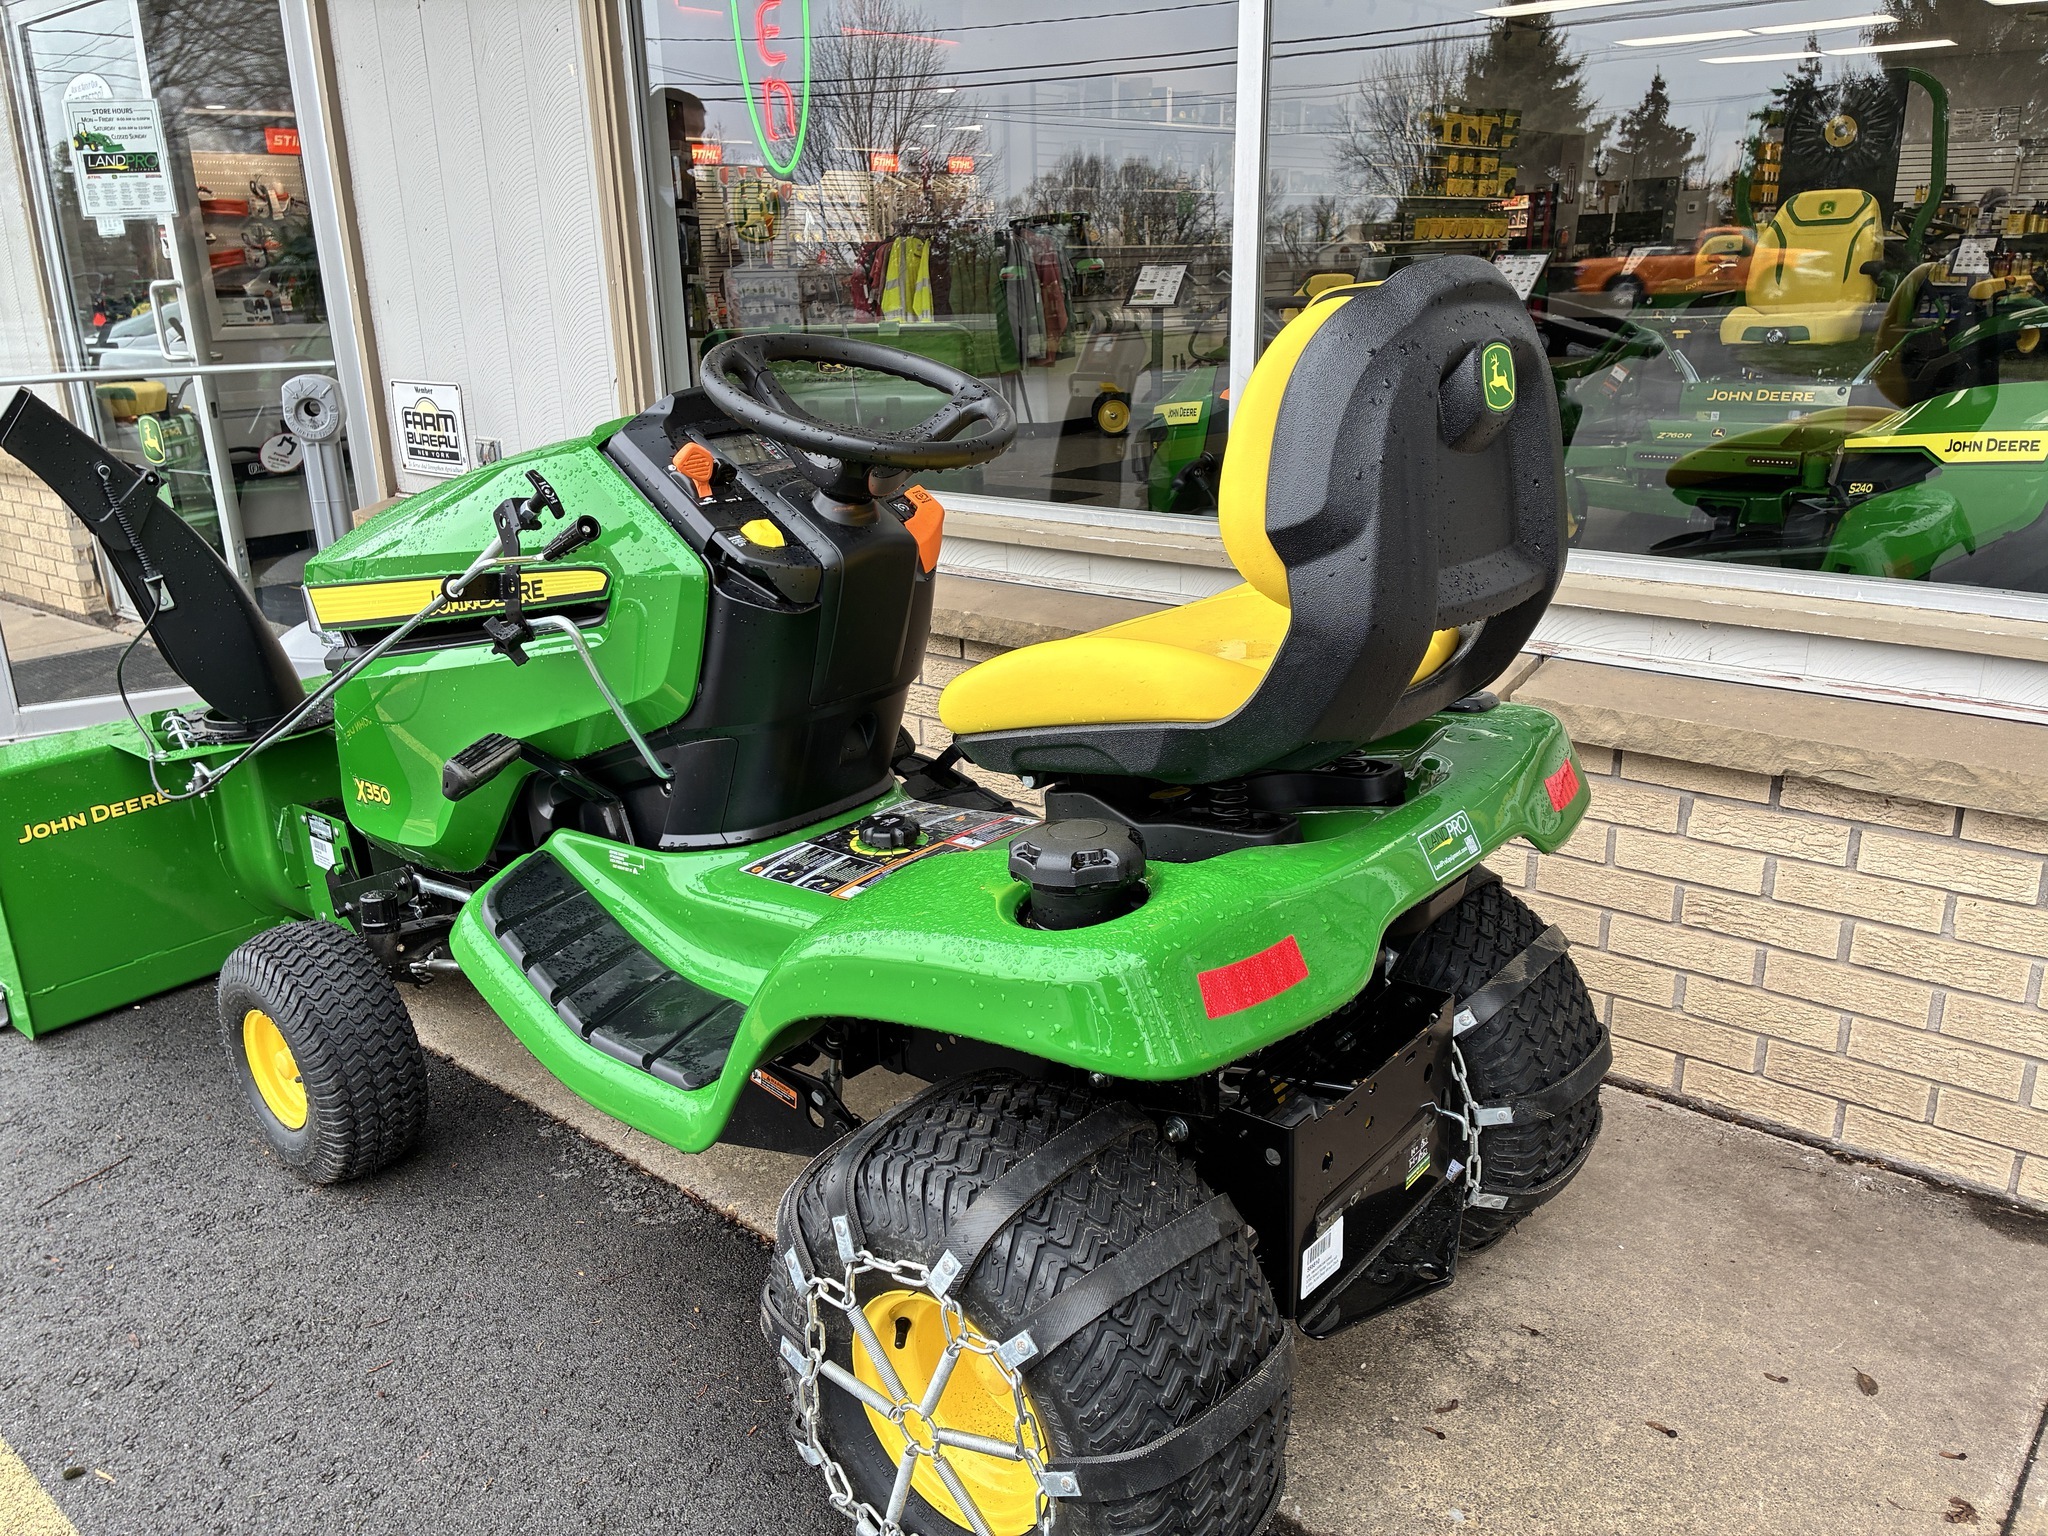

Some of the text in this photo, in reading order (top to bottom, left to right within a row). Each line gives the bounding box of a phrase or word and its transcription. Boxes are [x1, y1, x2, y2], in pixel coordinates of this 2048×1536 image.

[112, 107, 133, 115] HOURS
[88, 153, 159, 168] LANDPRO
[692, 149, 719, 160] STIHL
[873, 156, 896, 167] STIHL
[950, 160, 972, 169] STIHL
[1706, 388, 1815, 403] JOHN DEERE
[1167, 406, 1198, 418] JOHN DEERE
[404, 410, 456, 433] FARM
[406, 431, 459, 449] BUREAU
[1944, 438, 2041, 453] JOHN DEERE
[417, 449, 450, 459] NEW YORK
[1848, 482, 1874, 494] S240
[353, 776, 391, 805] X350
[18, 788, 172, 844] JOHN DEERE
[1425, 815, 1468, 851] LANDPRO
